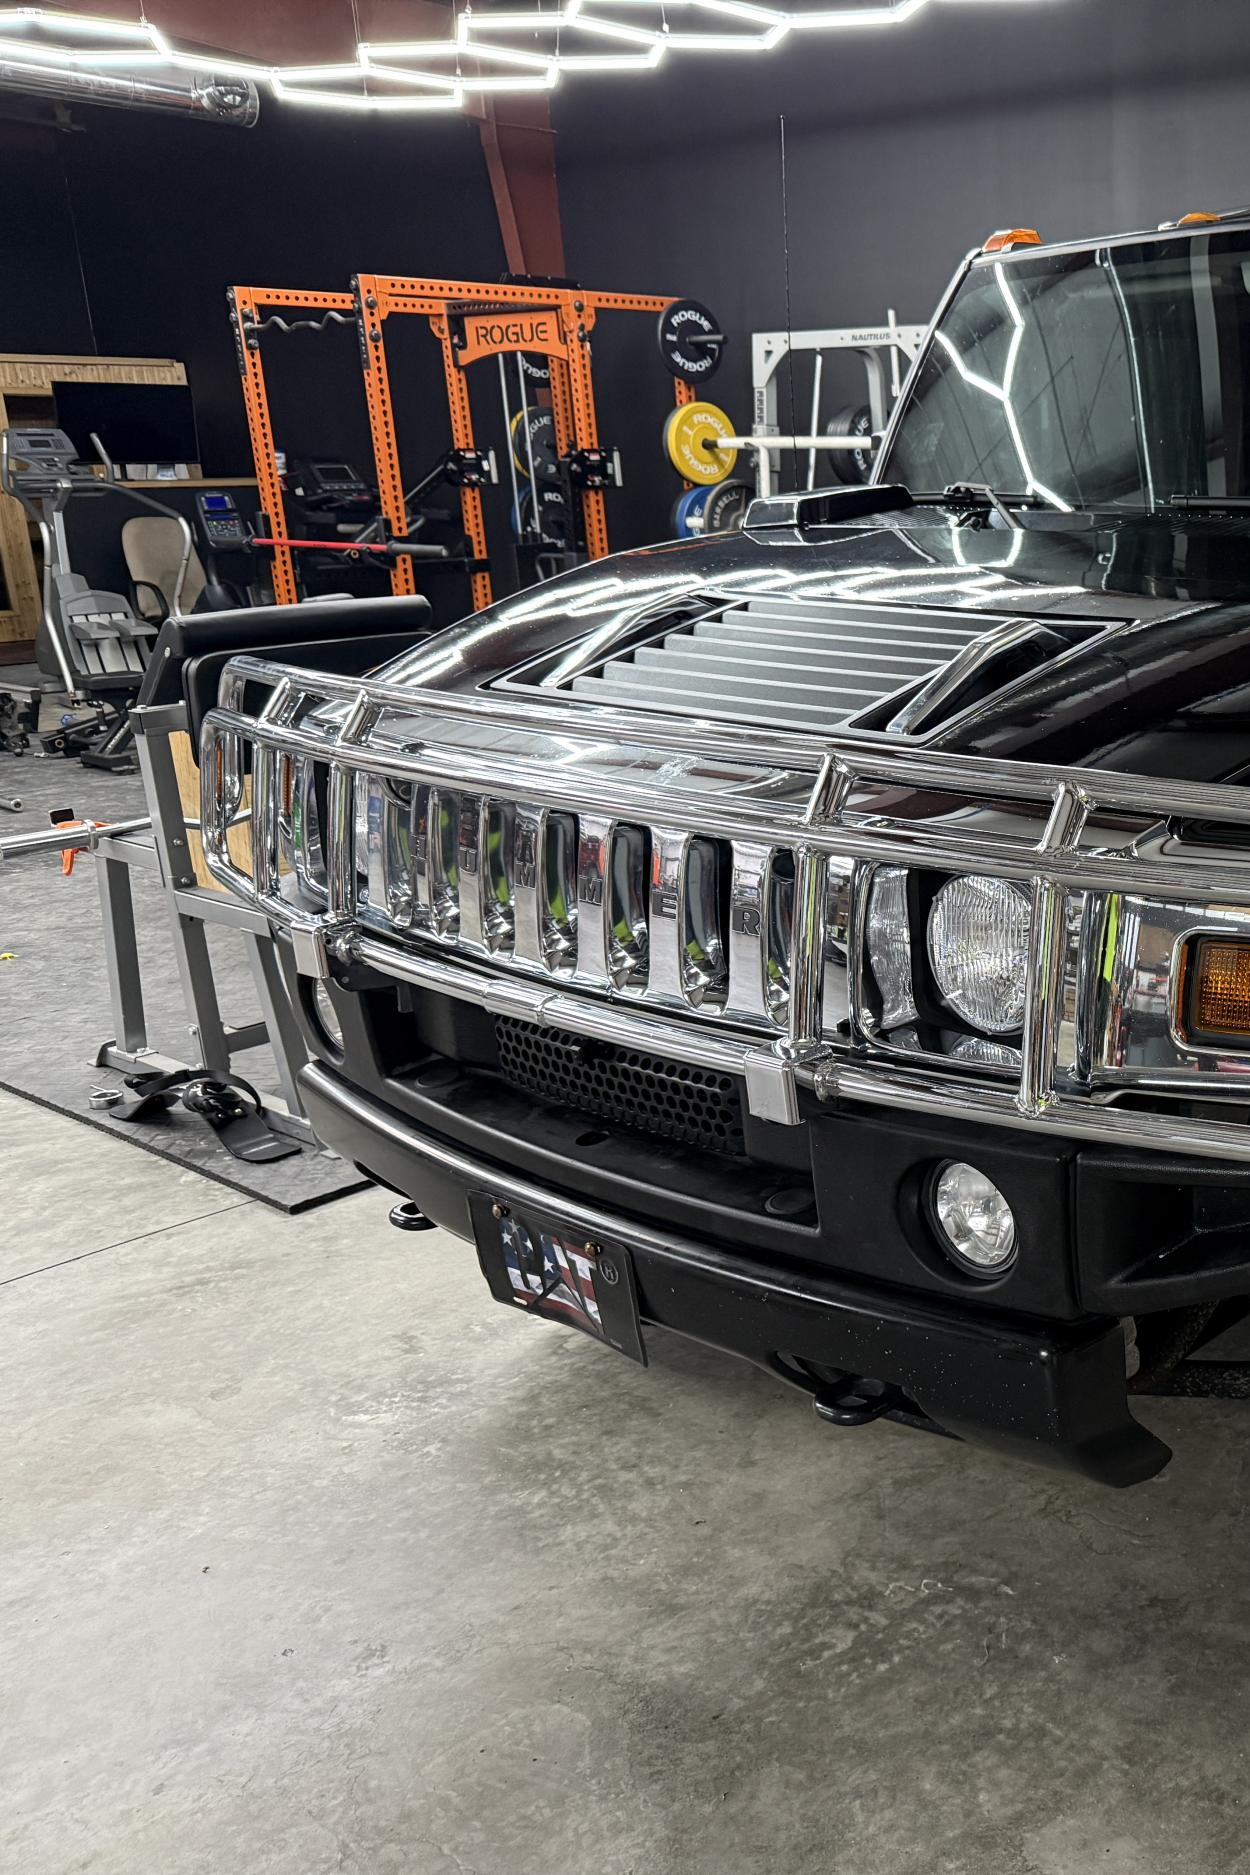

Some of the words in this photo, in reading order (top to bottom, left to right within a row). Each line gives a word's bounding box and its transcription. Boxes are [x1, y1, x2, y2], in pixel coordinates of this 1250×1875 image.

[671, 310, 713, 332] ROGUE
[475, 321, 549, 346] ROGUE
[851, 333, 891, 342] NAUTILUS
[670, 350, 712, 372] ROGUE
[680, 444, 719, 474] ROGUE
[712, 490, 740, 528] BARBELL
